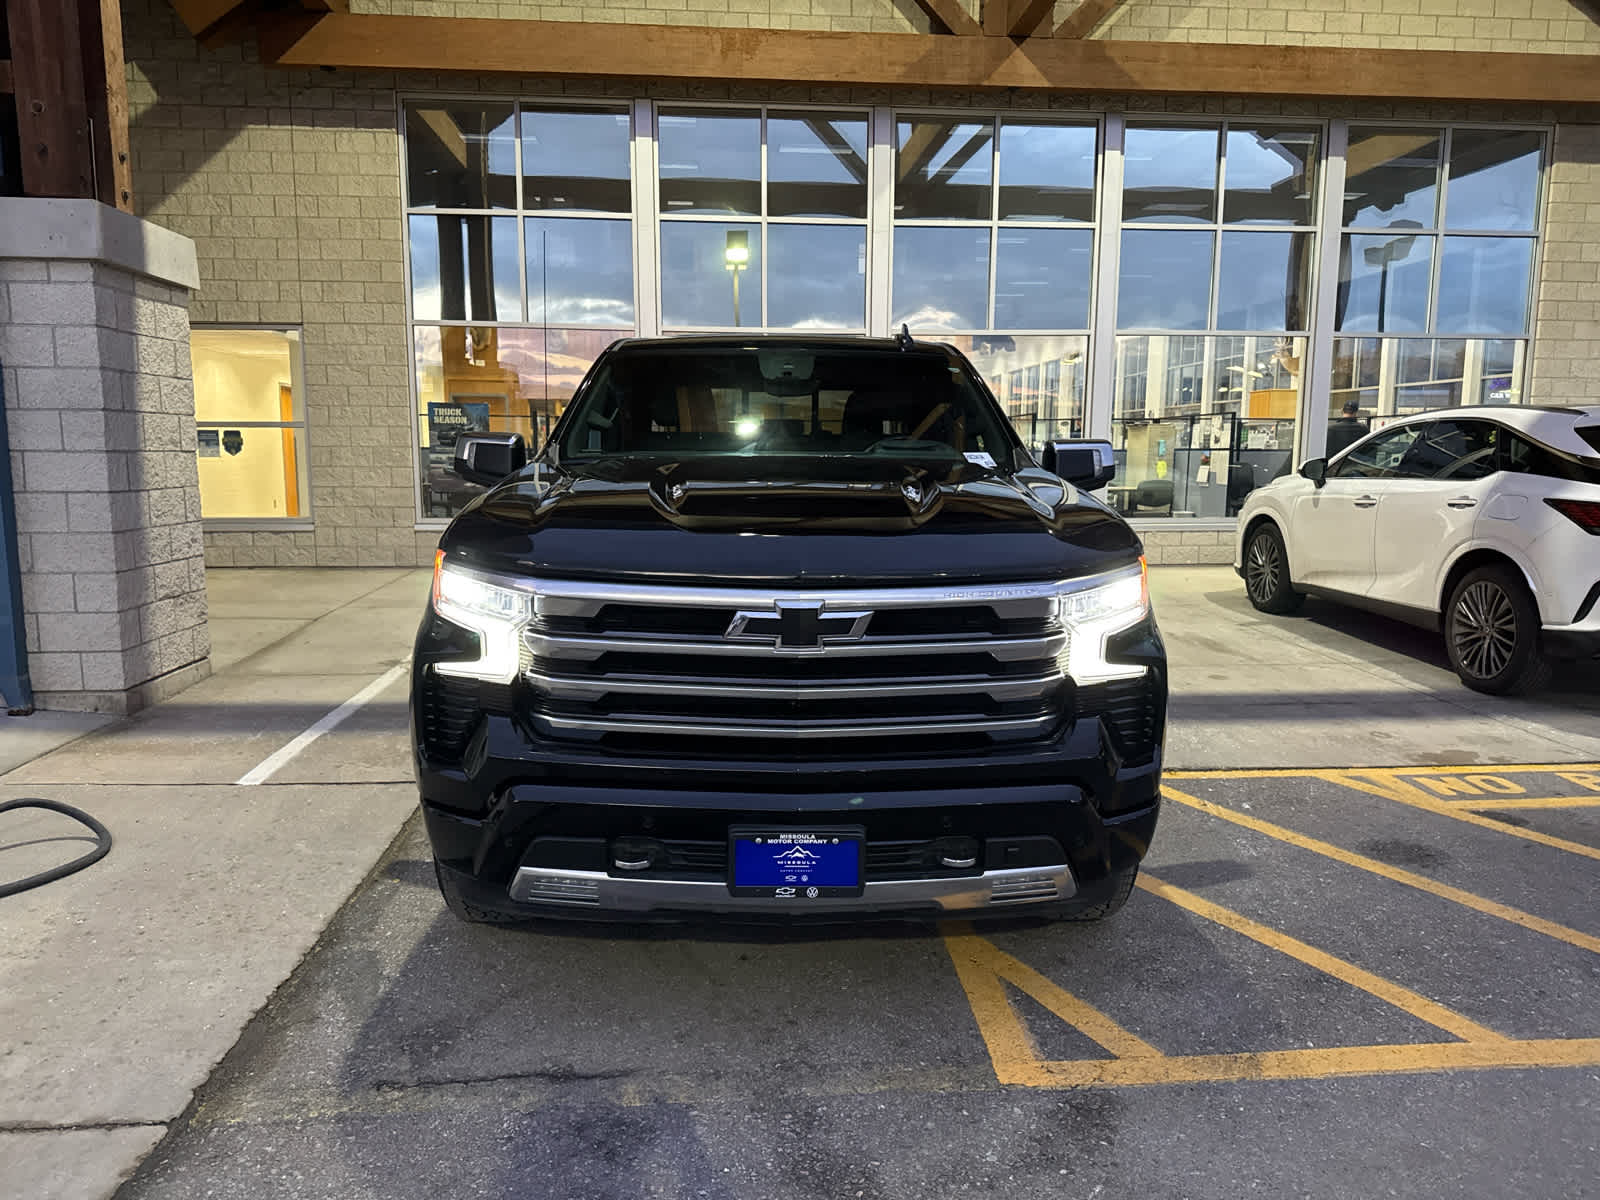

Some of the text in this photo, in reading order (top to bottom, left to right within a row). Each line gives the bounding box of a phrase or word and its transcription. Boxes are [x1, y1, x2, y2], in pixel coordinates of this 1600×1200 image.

[433, 407, 462, 416] TRUCK
[433, 416, 467, 424] SEASON
[1412, 774, 1527, 796] NO
